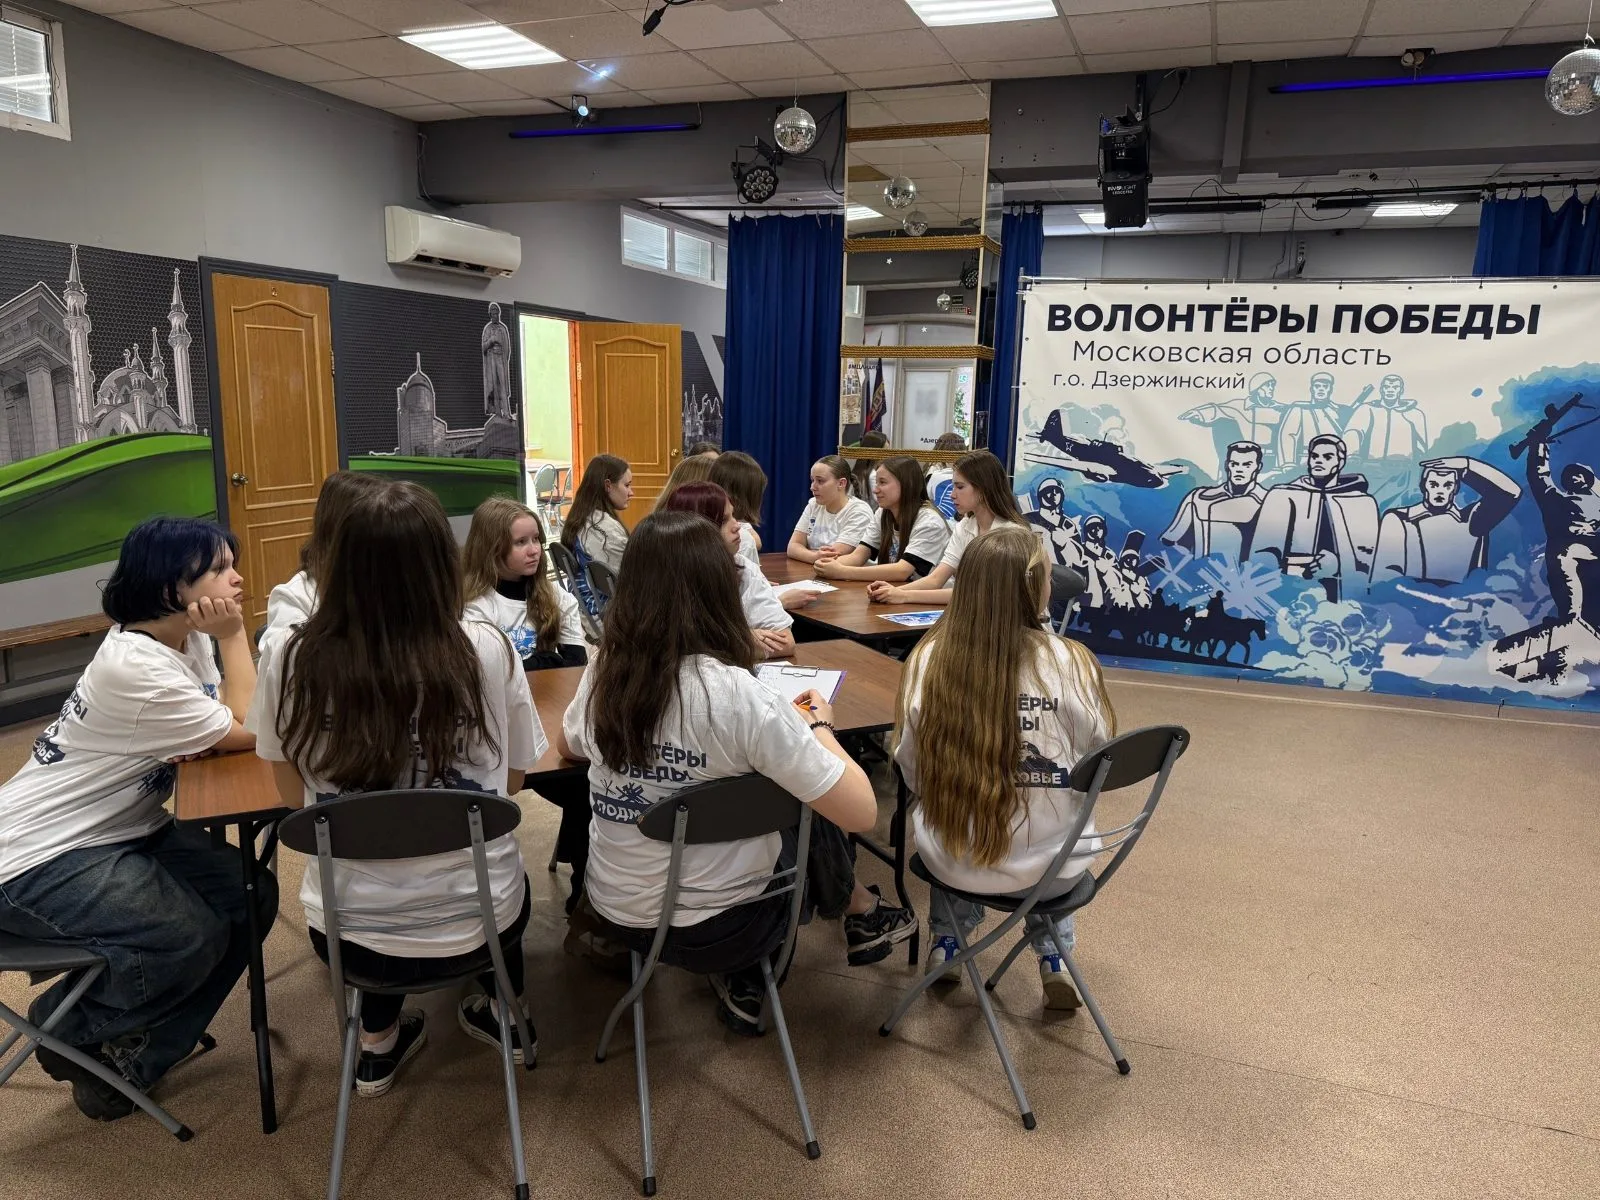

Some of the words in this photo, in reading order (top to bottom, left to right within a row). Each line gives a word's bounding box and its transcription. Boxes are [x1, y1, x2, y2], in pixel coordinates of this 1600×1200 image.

[1047, 296, 1319, 334] ВОЛОНТЁРЫ
[1331, 303, 1542, 341] ПОБЕДЫ
[1072, 340, 1252, 364] Московская
[1263, 342, 1392, 366] область
[1053, 373, 1085, 387] г.о.
[1091, 370, 1246, 391] Дзержинский
[1018, 693, 1059, 712] ЁРЫ
[596, 800, 642, 821] ПОДМ
